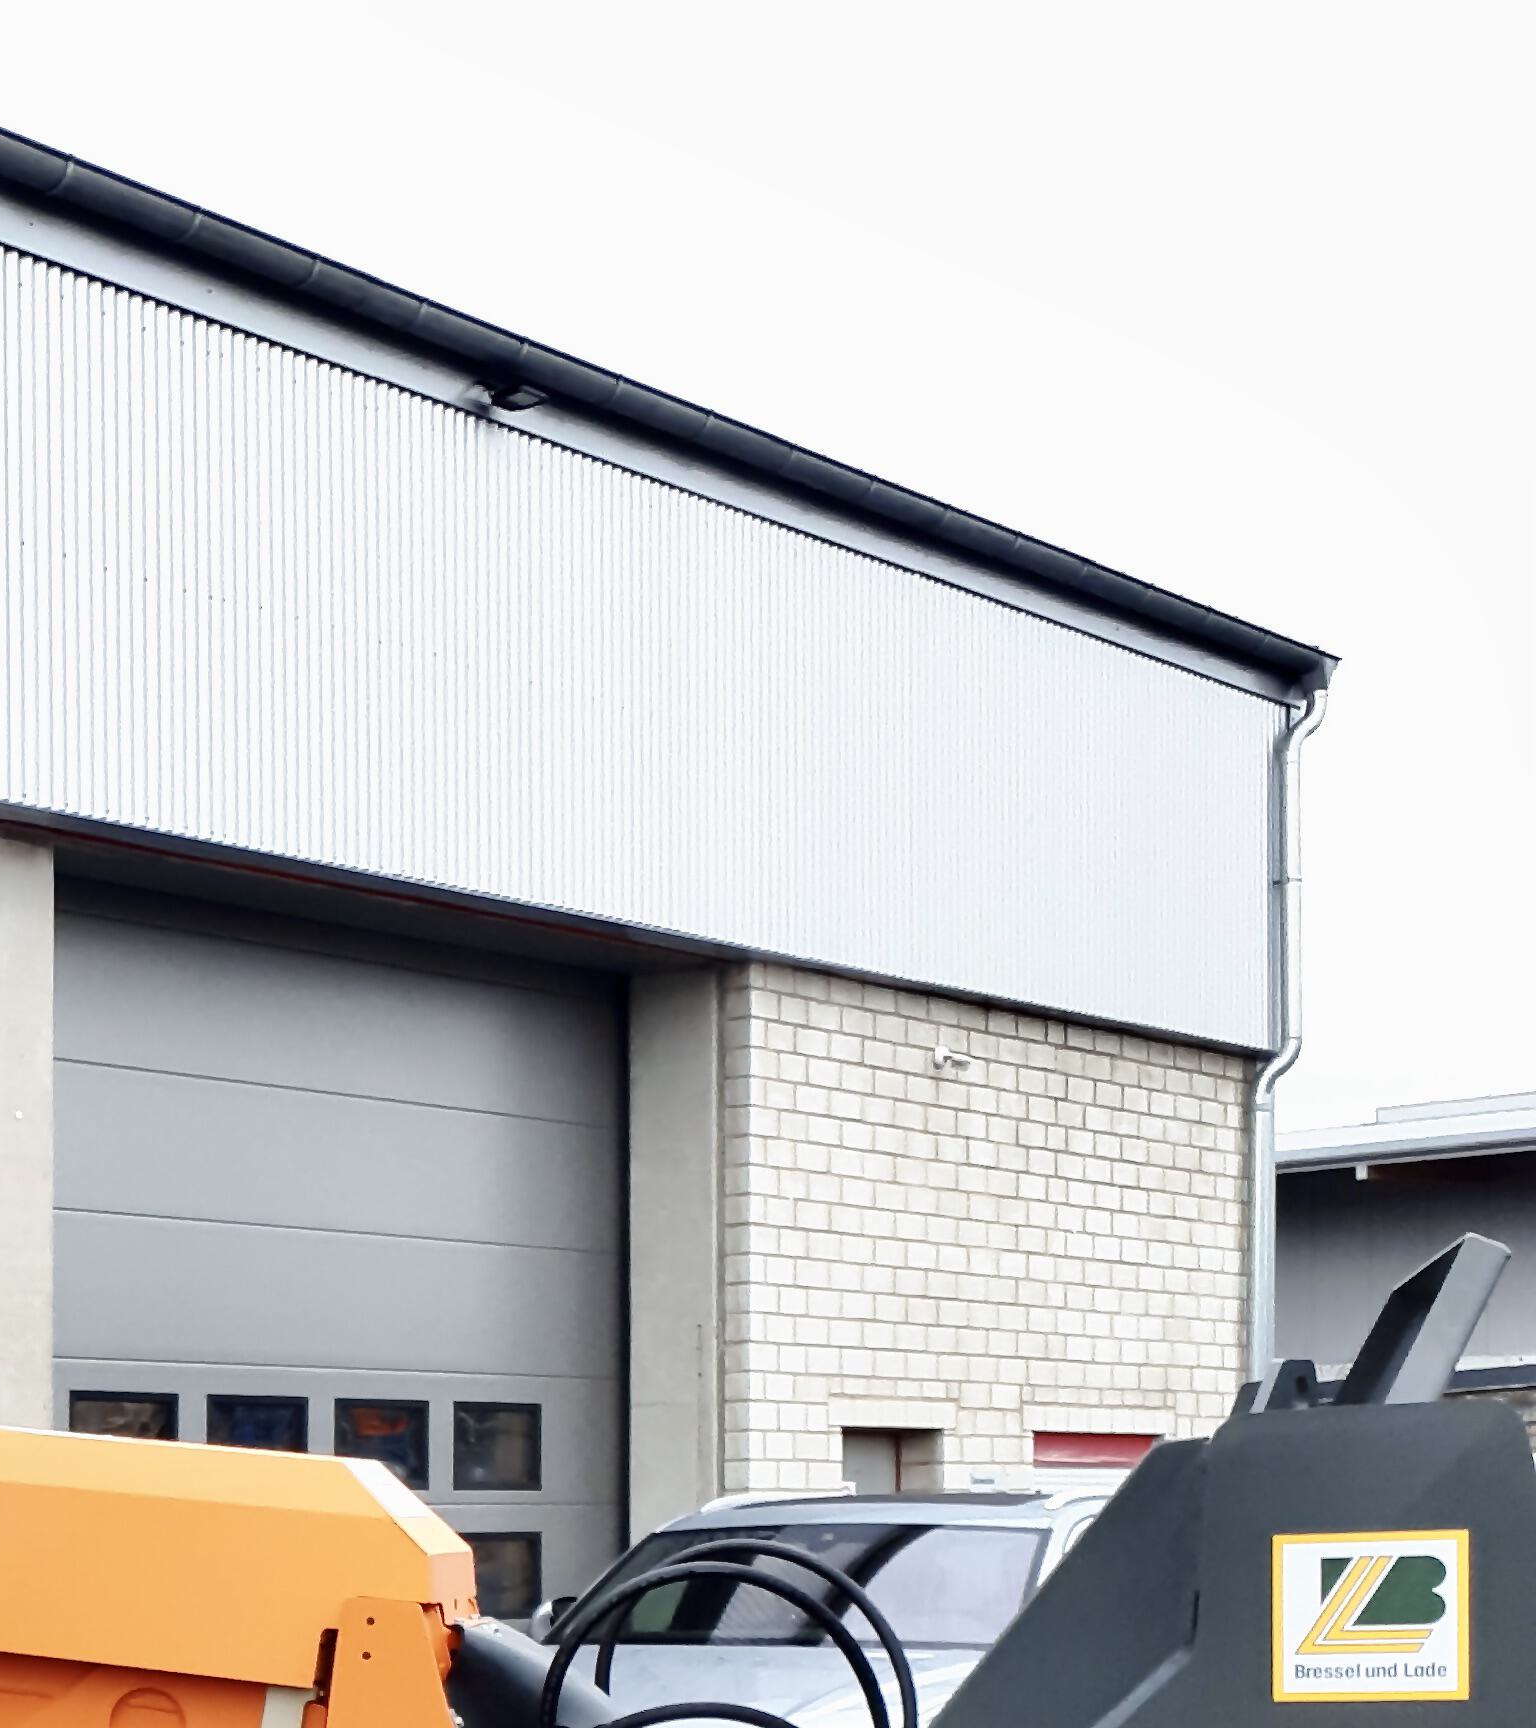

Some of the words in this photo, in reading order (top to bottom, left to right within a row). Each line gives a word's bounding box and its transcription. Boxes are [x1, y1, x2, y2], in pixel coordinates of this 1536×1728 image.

[1294, 1663, 1361, 1679] Bressel
[1365, 1662, 1398, 1678] und
[1403, 1661, 1448, 1678] Lade
